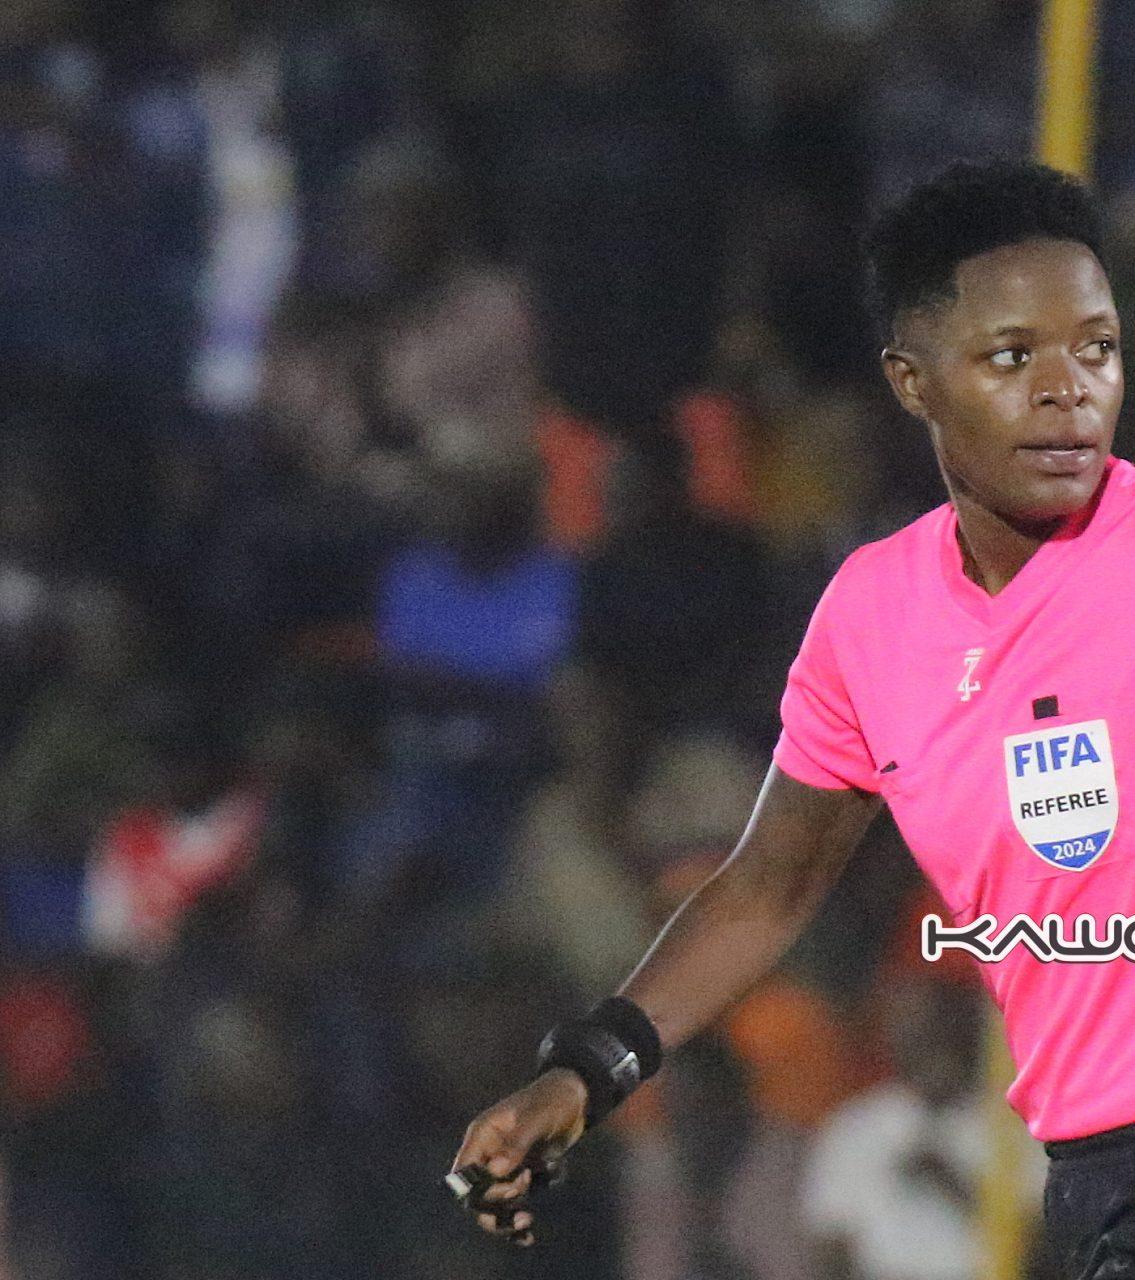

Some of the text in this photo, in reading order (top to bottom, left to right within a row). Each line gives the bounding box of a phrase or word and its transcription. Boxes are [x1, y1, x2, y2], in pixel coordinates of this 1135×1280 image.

[1013, 733, 1101, 777] FIFA
[1020, 788, 1109, 819] REFEREE
[1053, 838, 1096, 860] 2024
